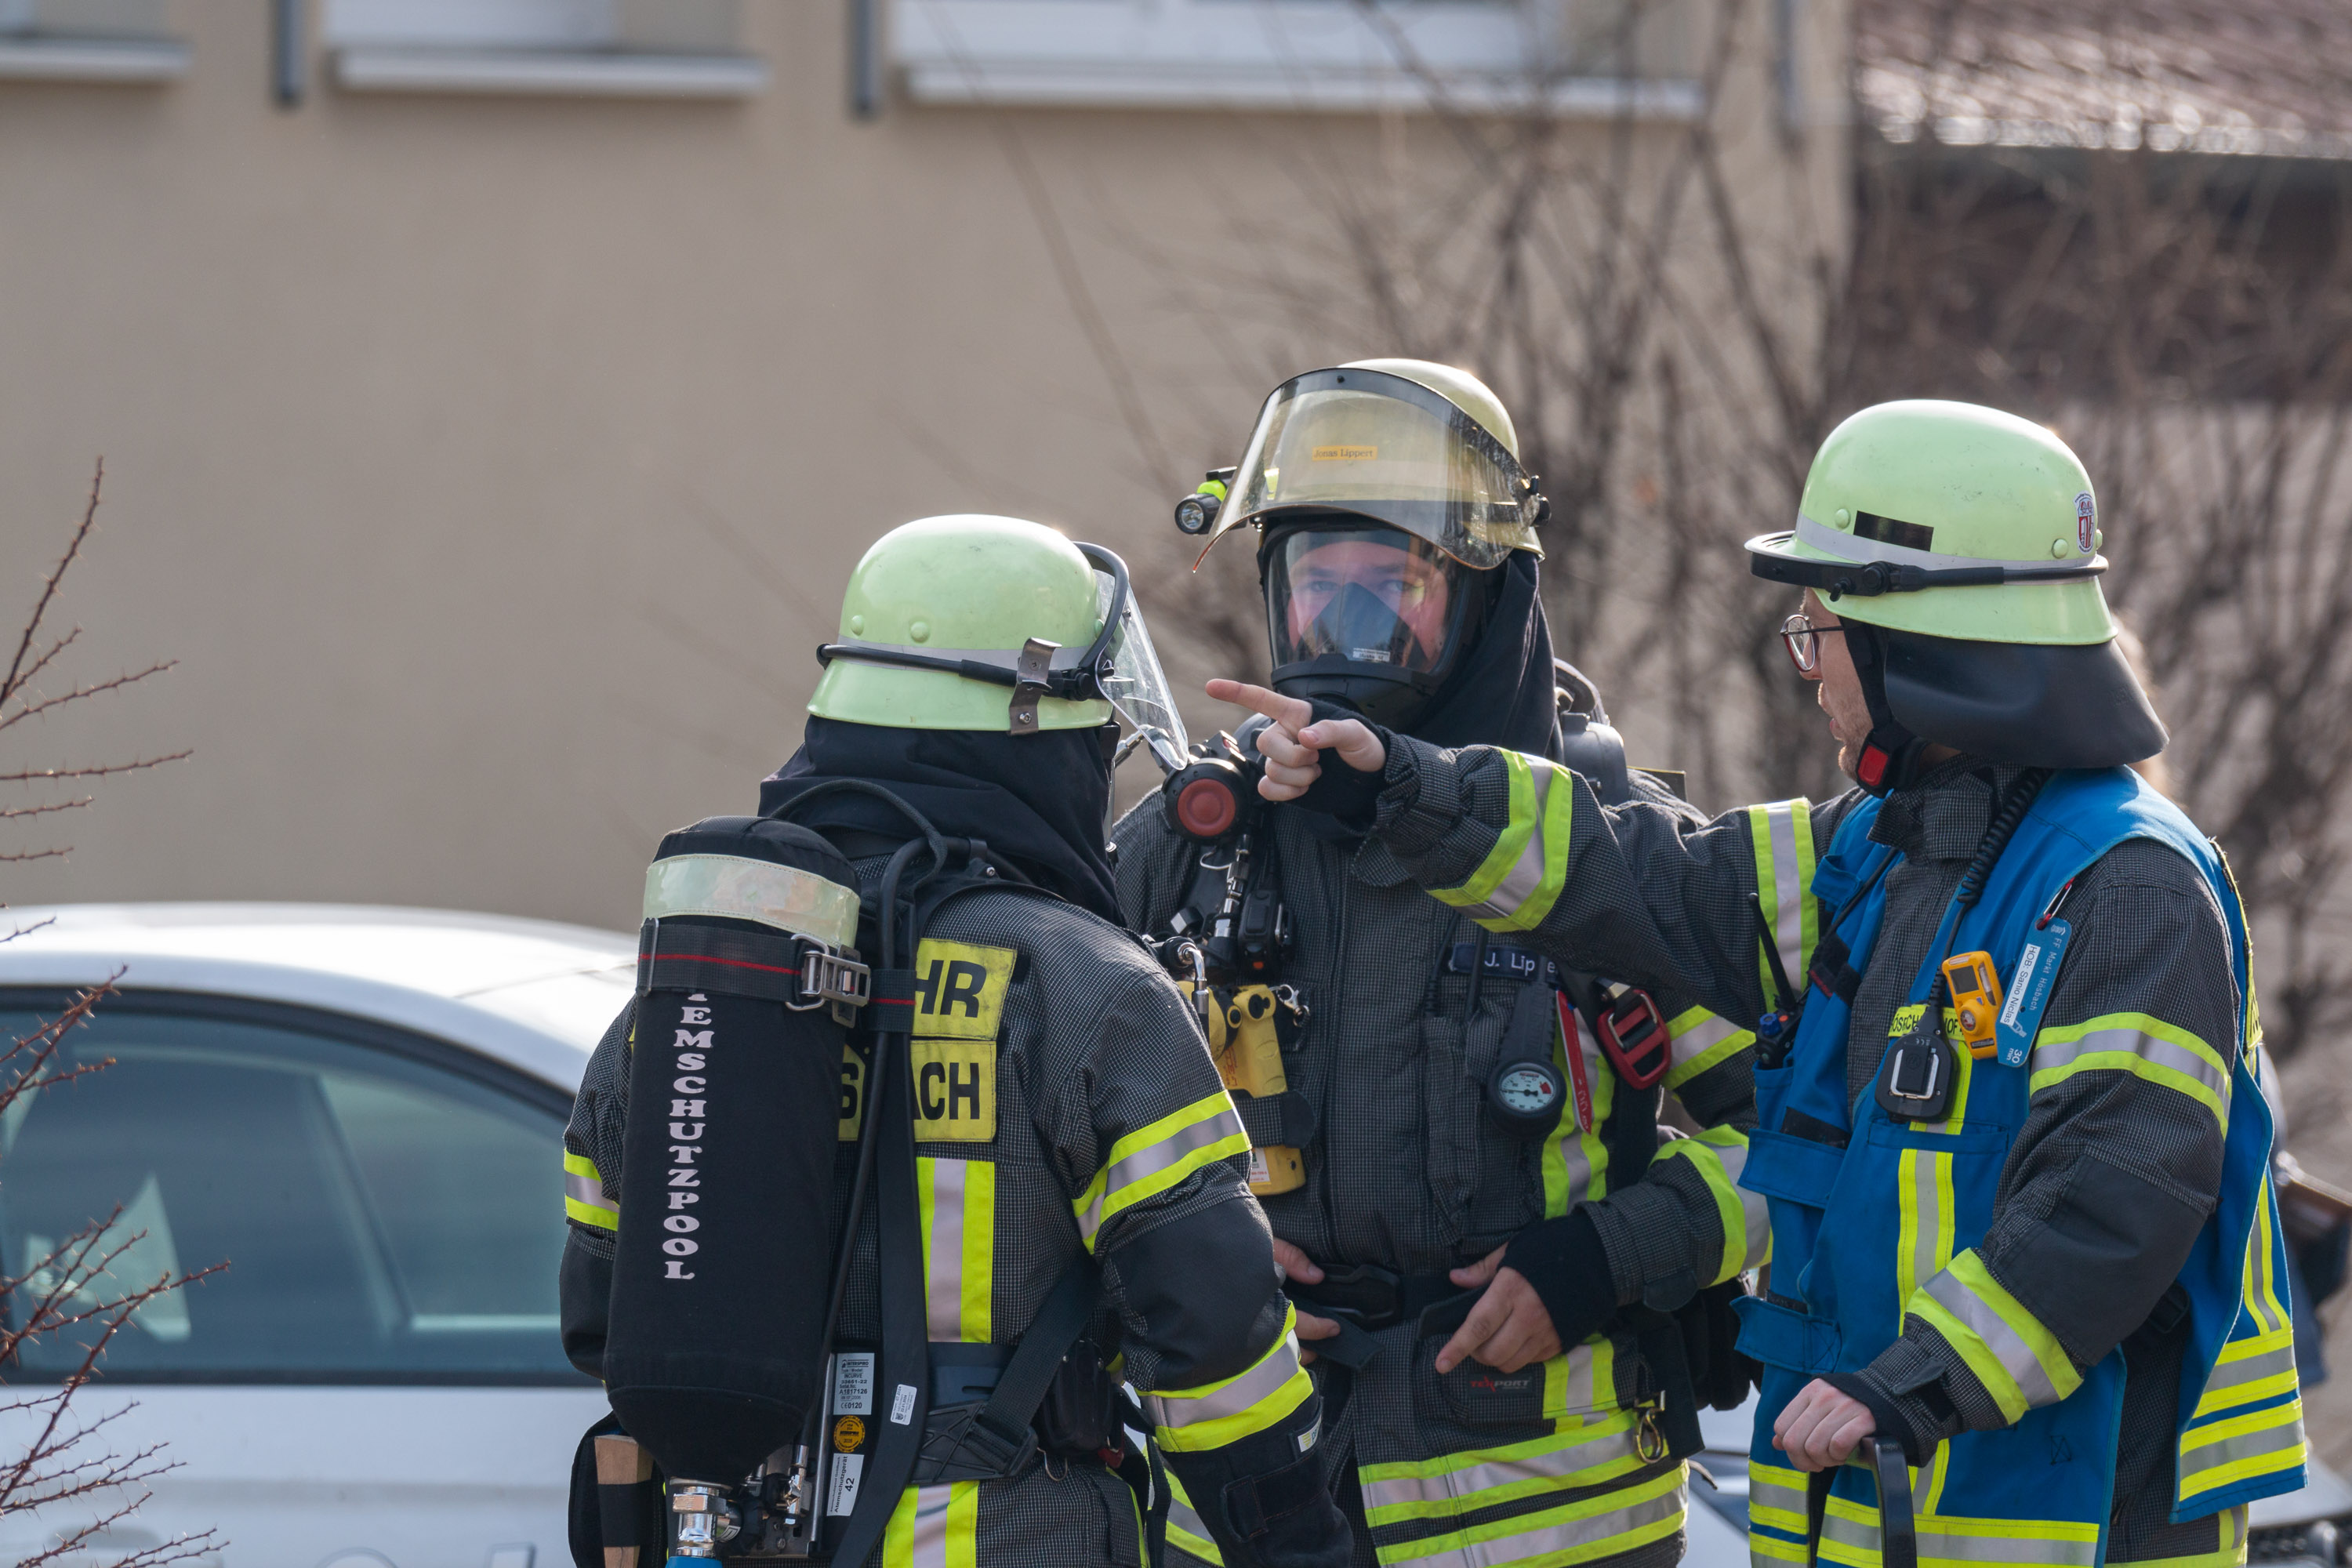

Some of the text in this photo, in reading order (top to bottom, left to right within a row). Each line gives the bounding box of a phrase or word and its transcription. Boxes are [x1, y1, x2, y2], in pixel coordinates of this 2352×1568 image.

[1313, 448, 1373, 459] Jonas Lippert
[1484, 952, 1500, 967] J.
[2029, 938, 2062, 1011] FF Markt Hösbach
[2003, 946, 2038, 1023] HOB: Sanio Niclas
[2011, 1049, 2023, 1064] 30
[662, 993, 715, 1279] EMSCHUTZPOOL
[834, 1456, 848, 1512] Atemschutzgerät
[844, 1478, 855, 1492] 42
